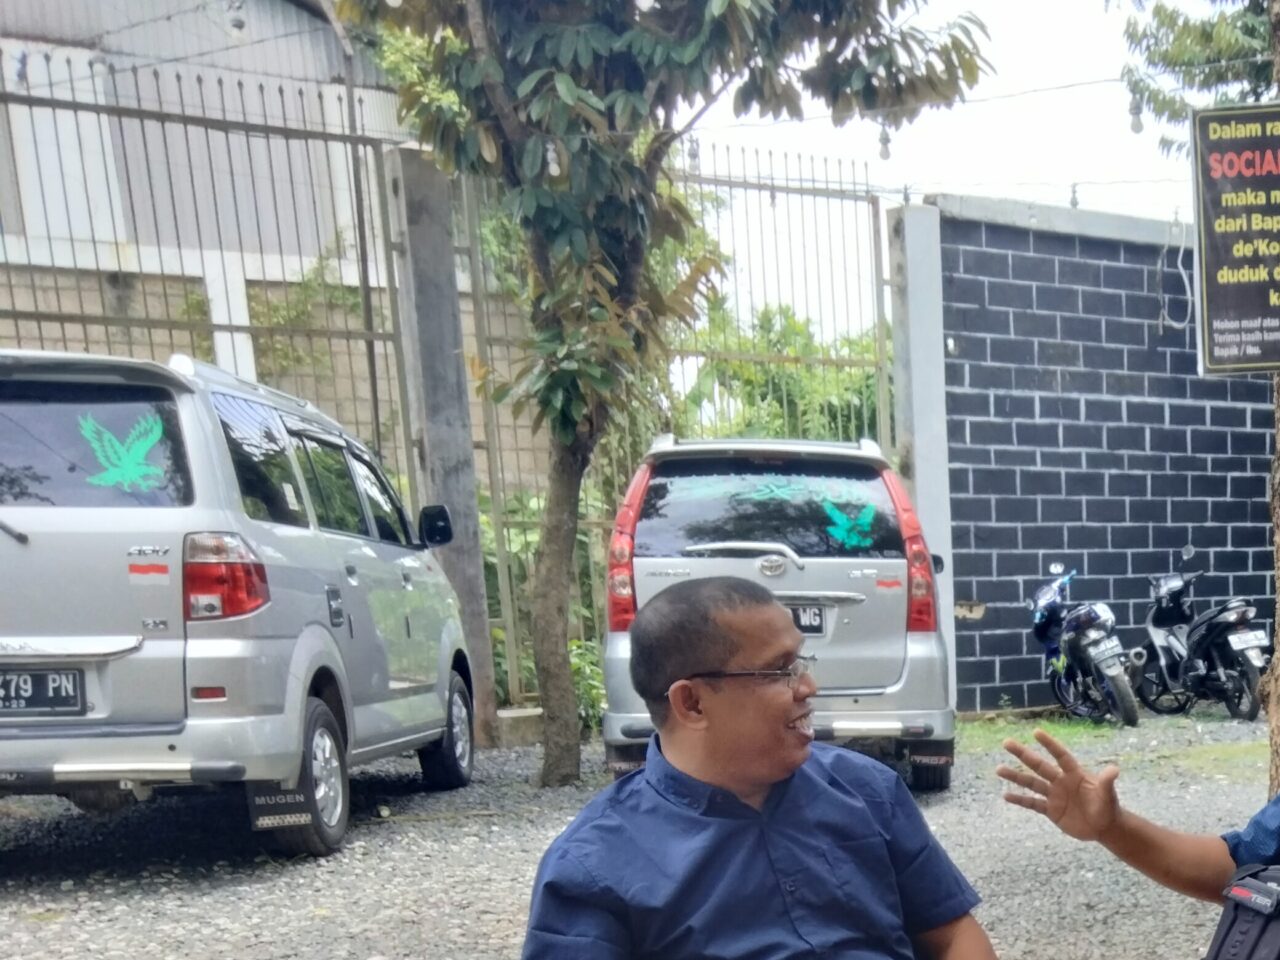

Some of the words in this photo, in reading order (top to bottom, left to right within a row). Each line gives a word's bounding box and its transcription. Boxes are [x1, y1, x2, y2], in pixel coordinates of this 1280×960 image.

[1209, 121, 1262, 140] Dalam
[1221, 189, 1266, 207] maka
[1214, 215, 1247, 233] dari
[1217, 265, 1270, 284] duduk
[799, 607, 821, 627] WG
[47, 673, 75, 697] PN
[254, 794, 305, 805] MUGEN
